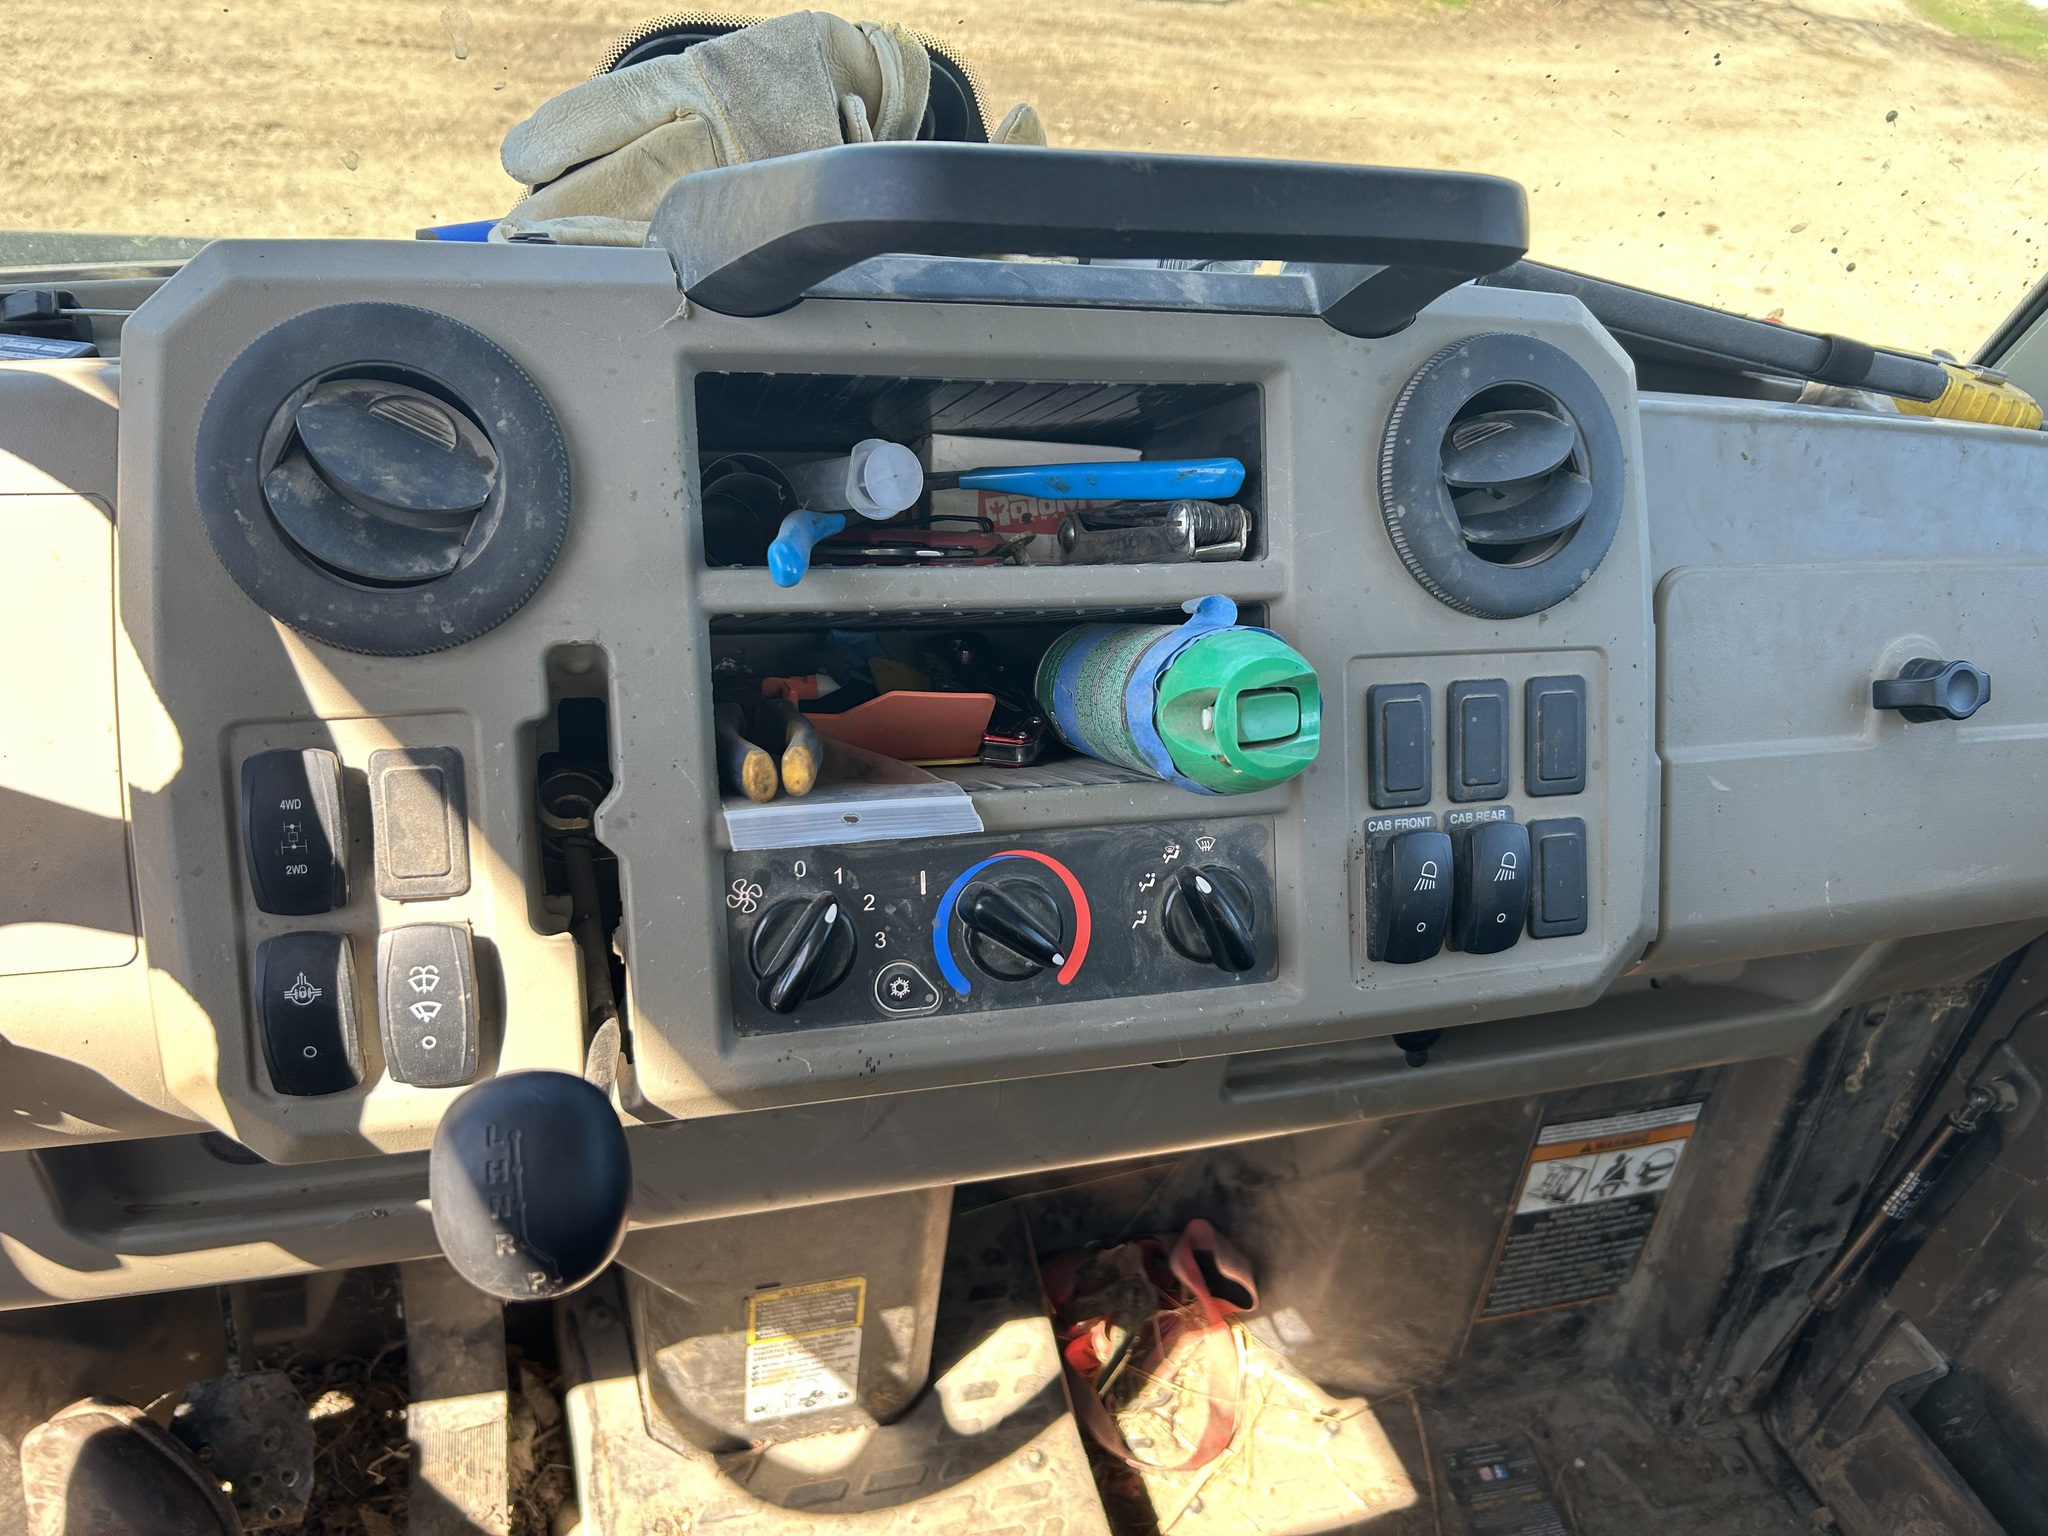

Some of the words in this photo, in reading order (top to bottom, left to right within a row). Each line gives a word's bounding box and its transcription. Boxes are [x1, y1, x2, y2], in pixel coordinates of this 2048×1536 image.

[279, 798, 302, 811] 4WD
[1367, 820, 1392, 832] CAB
[1395, 816, 1432, 830] FRONT
[1449, 812, 1473, 824] CAB
[1476, 809, 1506, 822] REAR
[286, 863, 308, 876] 2WD
[794, 860, 807, 878] 0
[834, 867, 843, 885] 1
[863, 894, 876, 911] 2
[874, 931, 887, 949] 3
[485, 1124, 504, 1148] L
[486, 1158, 510, 1185] H
[488, 1195, 511, 1219] N
[495, 1233, 517, 1257] R
[526, 1271, 546, 1292] P
